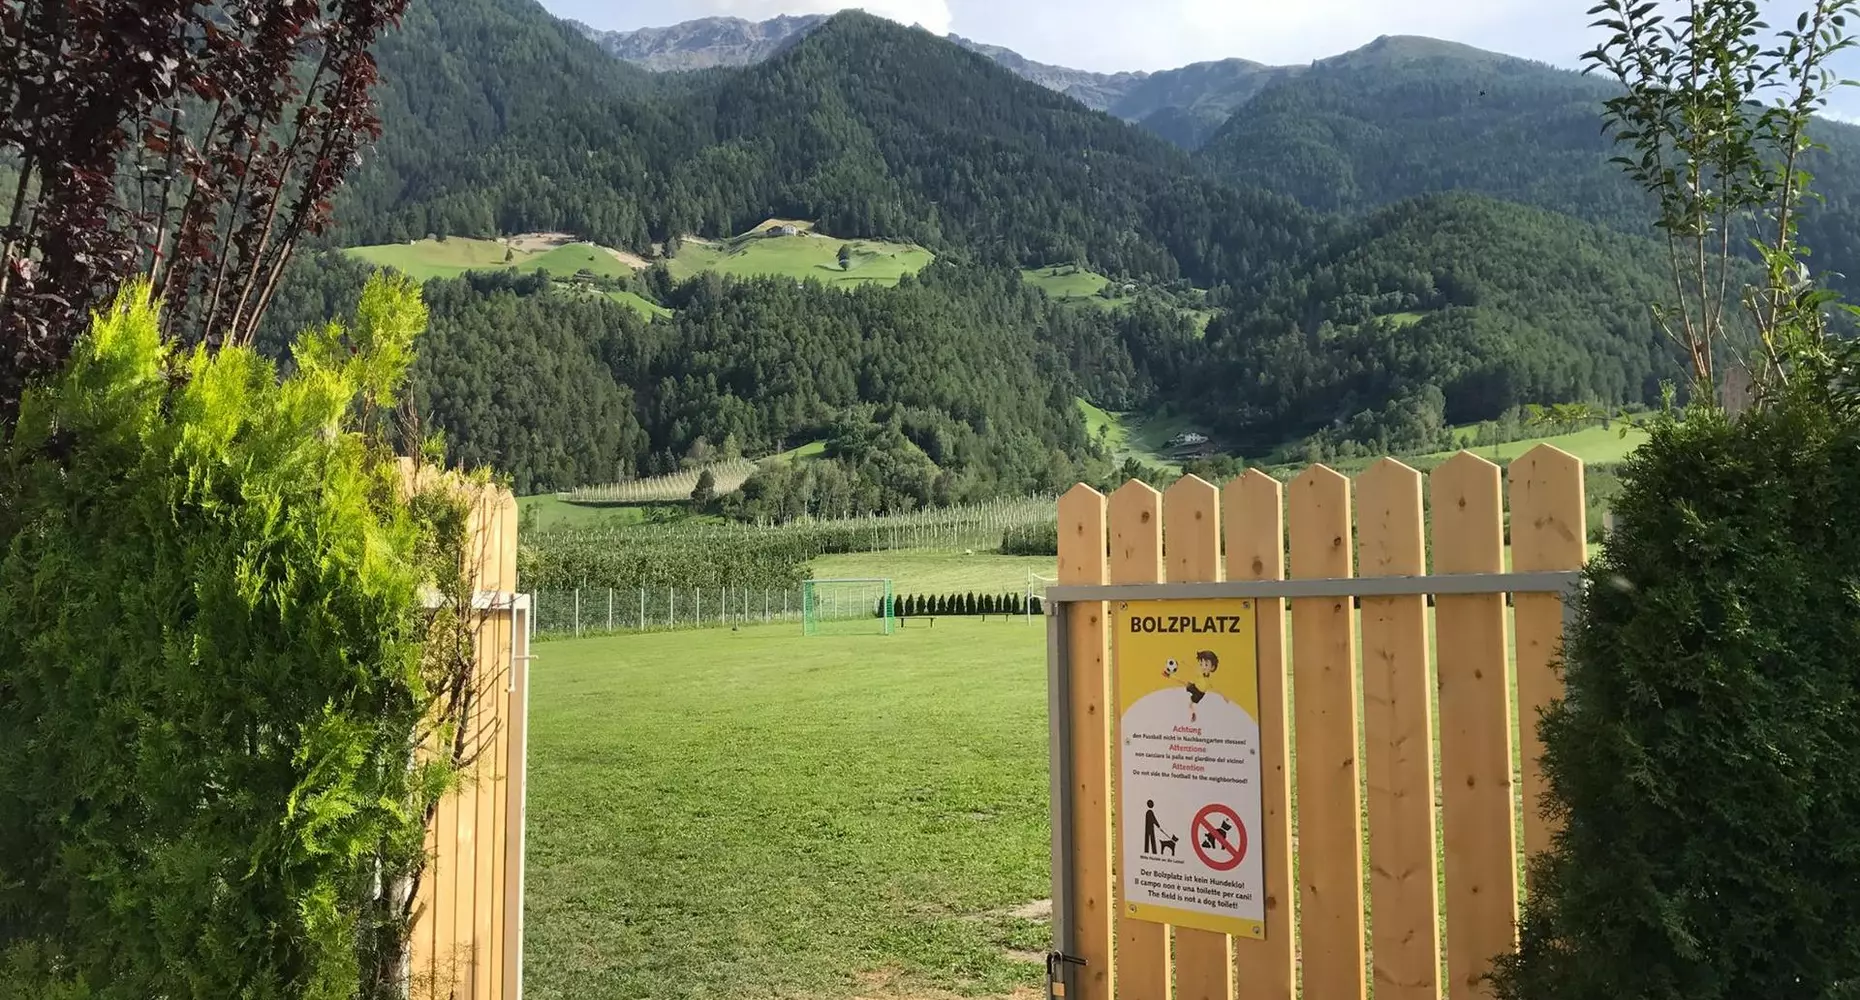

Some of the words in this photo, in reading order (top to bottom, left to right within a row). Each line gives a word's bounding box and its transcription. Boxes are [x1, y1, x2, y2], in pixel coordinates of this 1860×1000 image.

[1130, 616, 1241, 633] BOLZPLATZ
[1173, 725, 1202, 736] Achtung
[1169, 744, 1207, 753] Attenzione
[1172, 762, 1205, 772] Attention
[1170, 772, 1192, 780] football
[1140, 868, 1152, 877] Der
[1153, 870, 1183, 881] Bolzplatz
[1183, 874, 1193, 882] ist
[1193, 875, 1209, 884] kein
[1209, 878, 1245, 889] Hundeklo!
[1134, 877, 1140, 885] Il
[1140, 880, 1162, 890] campo
[1196, 887, 1221, 897] toilette
[1222, 891, 1235, 899] per
[1235, 892, 1253, 901] cani!
[1147, 889, 1160, 899] The
[1160, 891, 1176, 900] field
[1203, 897, 1217, 908] dog
[1217, 900, 1239, 909] toilet!
